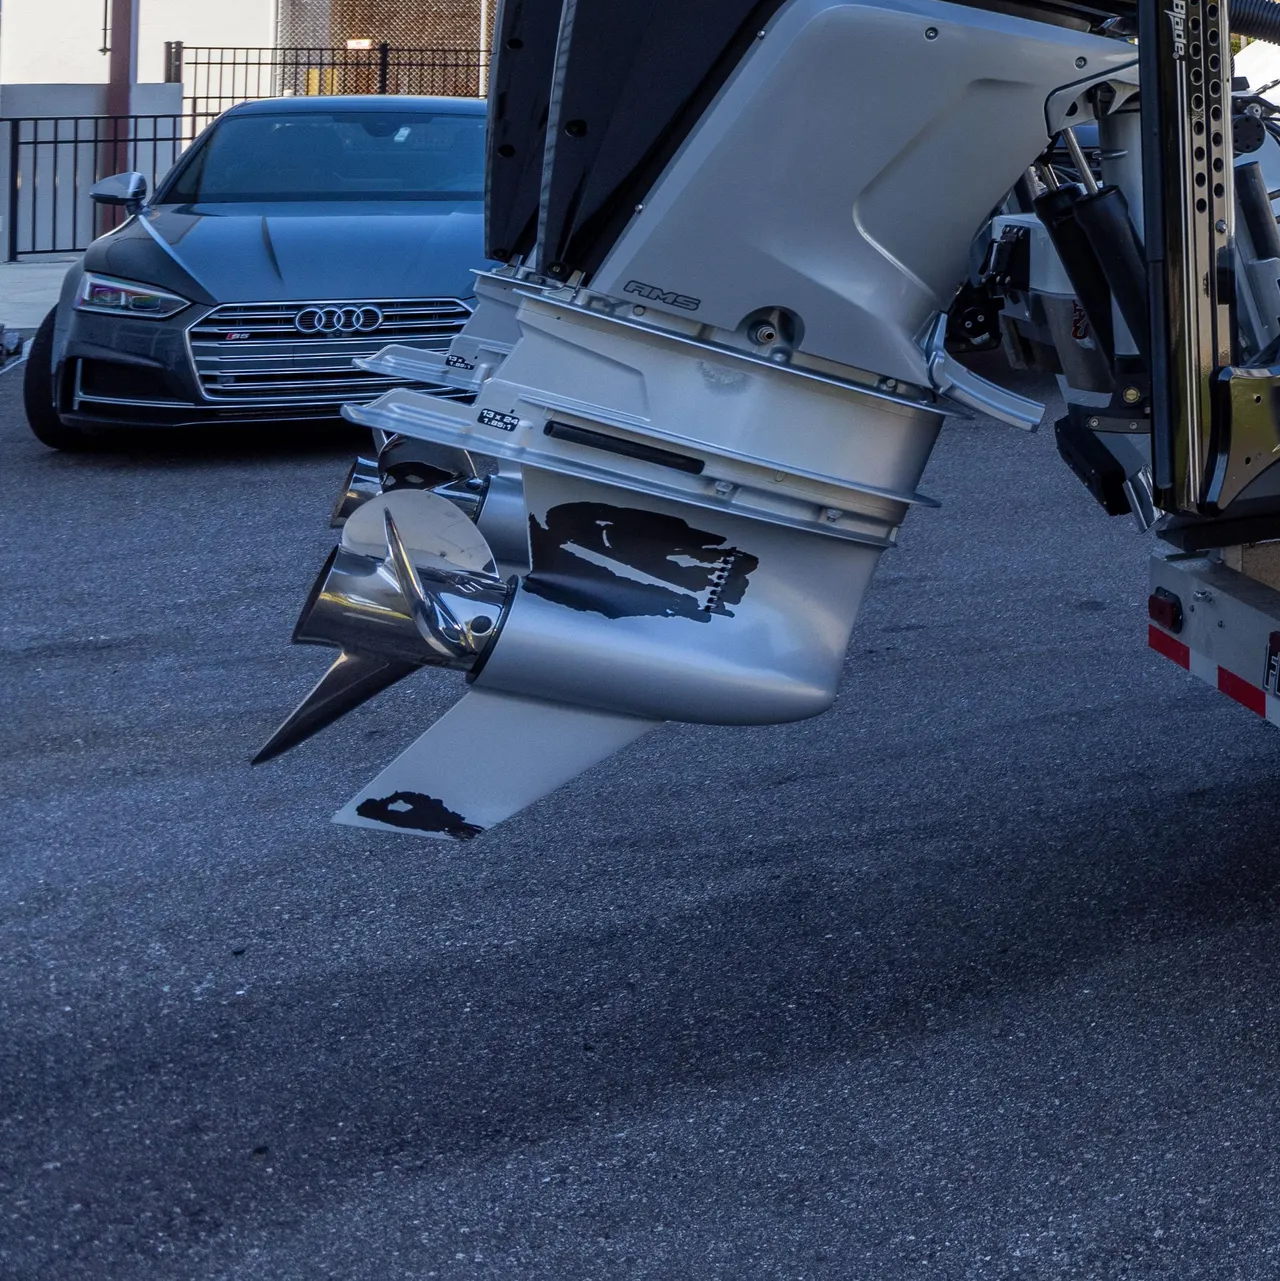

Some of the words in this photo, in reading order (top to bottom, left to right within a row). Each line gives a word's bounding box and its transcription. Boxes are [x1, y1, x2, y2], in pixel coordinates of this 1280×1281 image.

[623, 280, 701, 311] AMS
[482, 409, 495, 418] 13
[503, 416, 519, 425] 24
